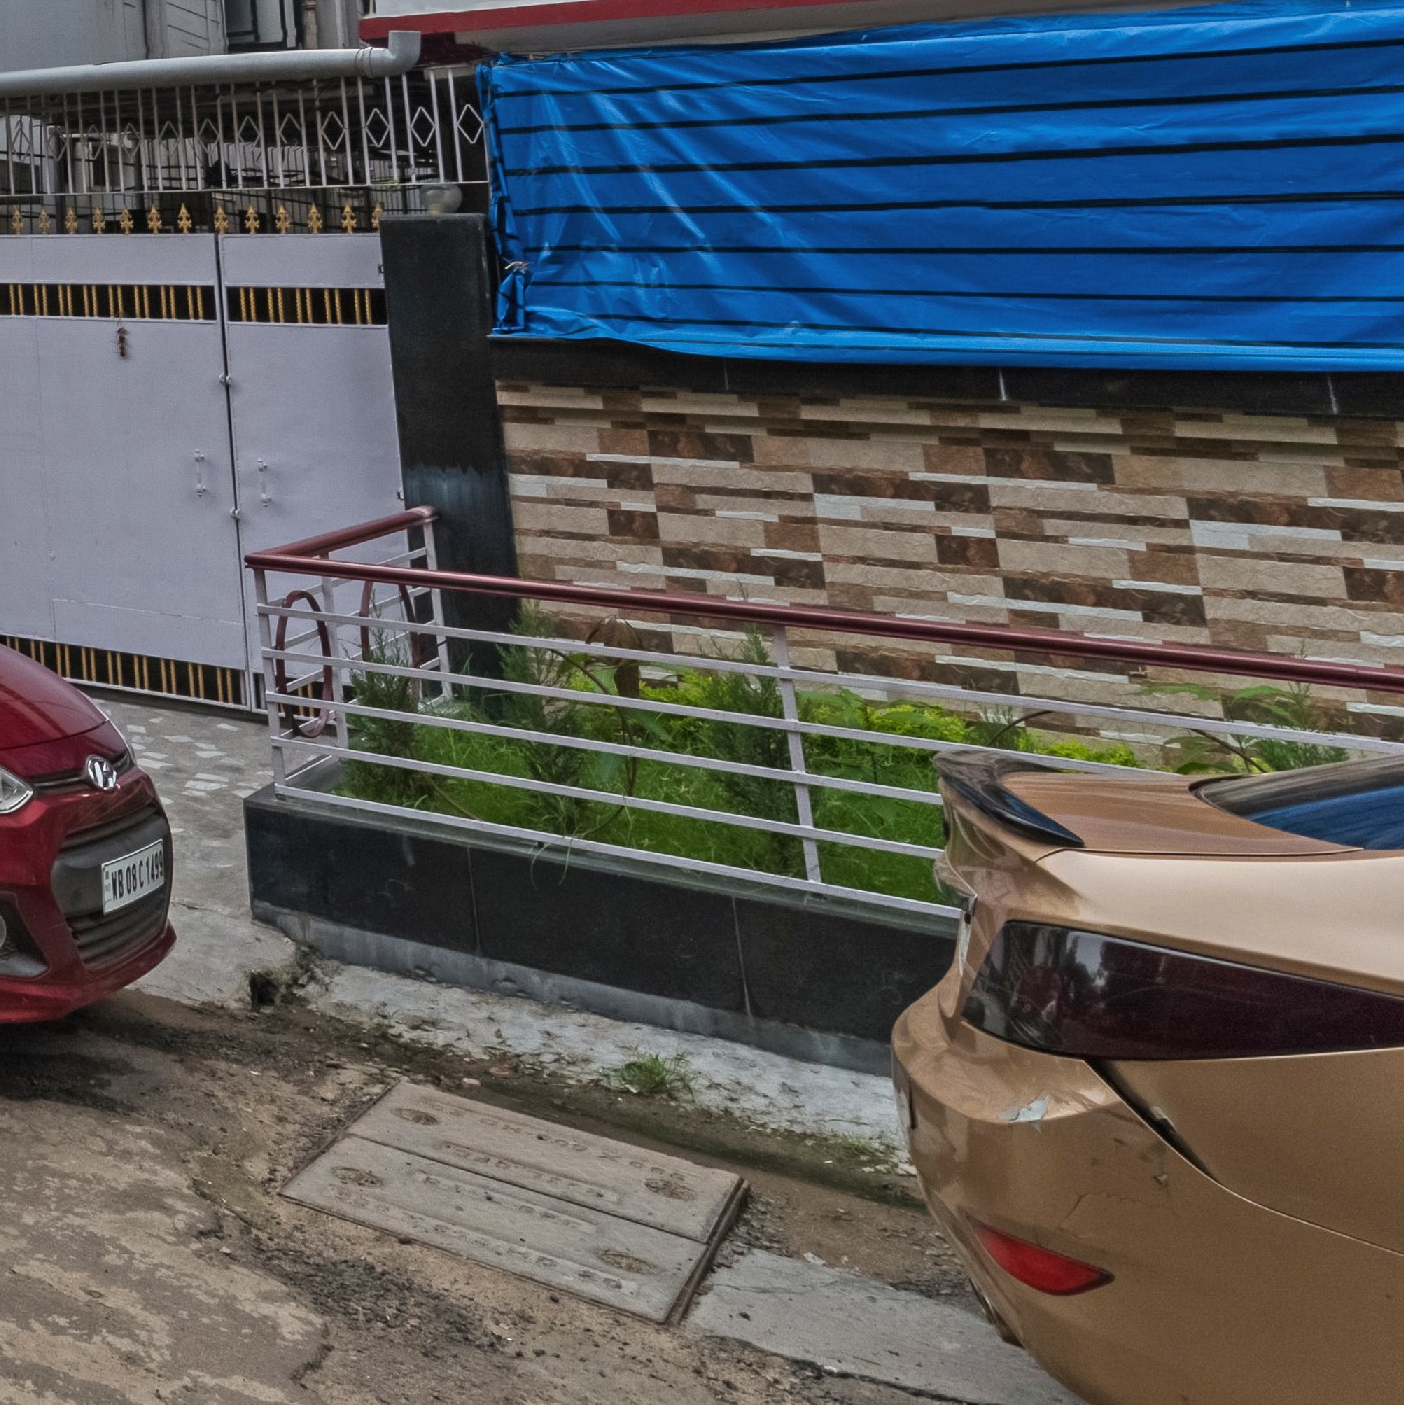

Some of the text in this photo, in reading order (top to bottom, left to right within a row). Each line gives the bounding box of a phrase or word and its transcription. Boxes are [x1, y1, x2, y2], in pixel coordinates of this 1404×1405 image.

[111, 868, 125, 901] WB
[125, 863, 137, 895] 08
[138, 859, 145, 889] C
